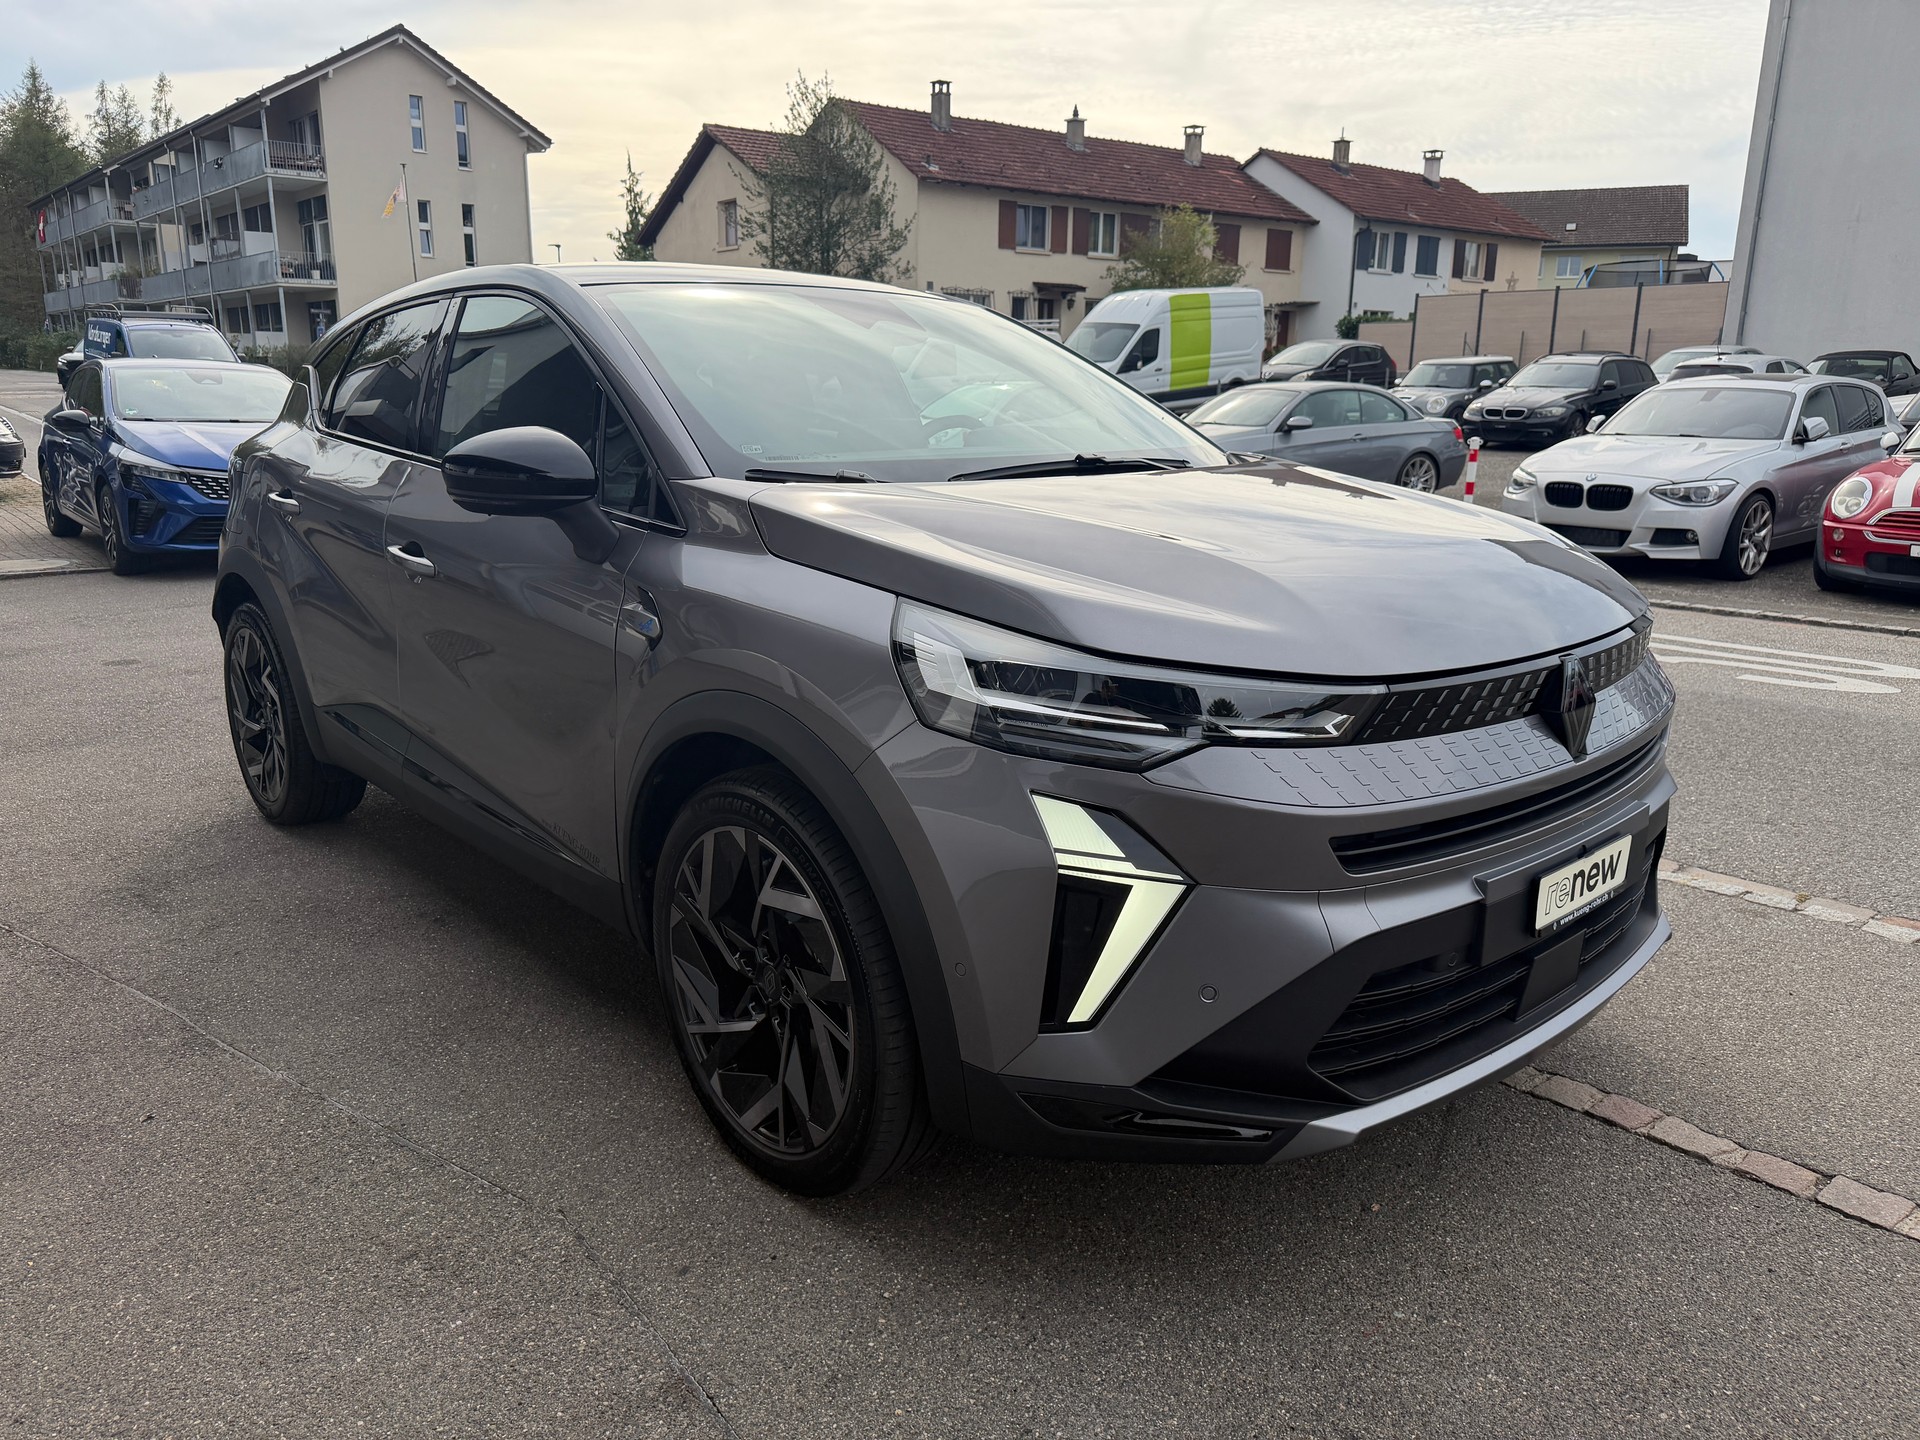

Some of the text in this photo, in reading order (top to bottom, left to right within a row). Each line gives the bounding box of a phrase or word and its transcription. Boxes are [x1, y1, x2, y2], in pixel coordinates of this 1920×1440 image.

[708, 797, 775, 828] MICHELIN
[792, 846, 834, 908] PRIMACY
[1545, 850, 1622, 915] renew
